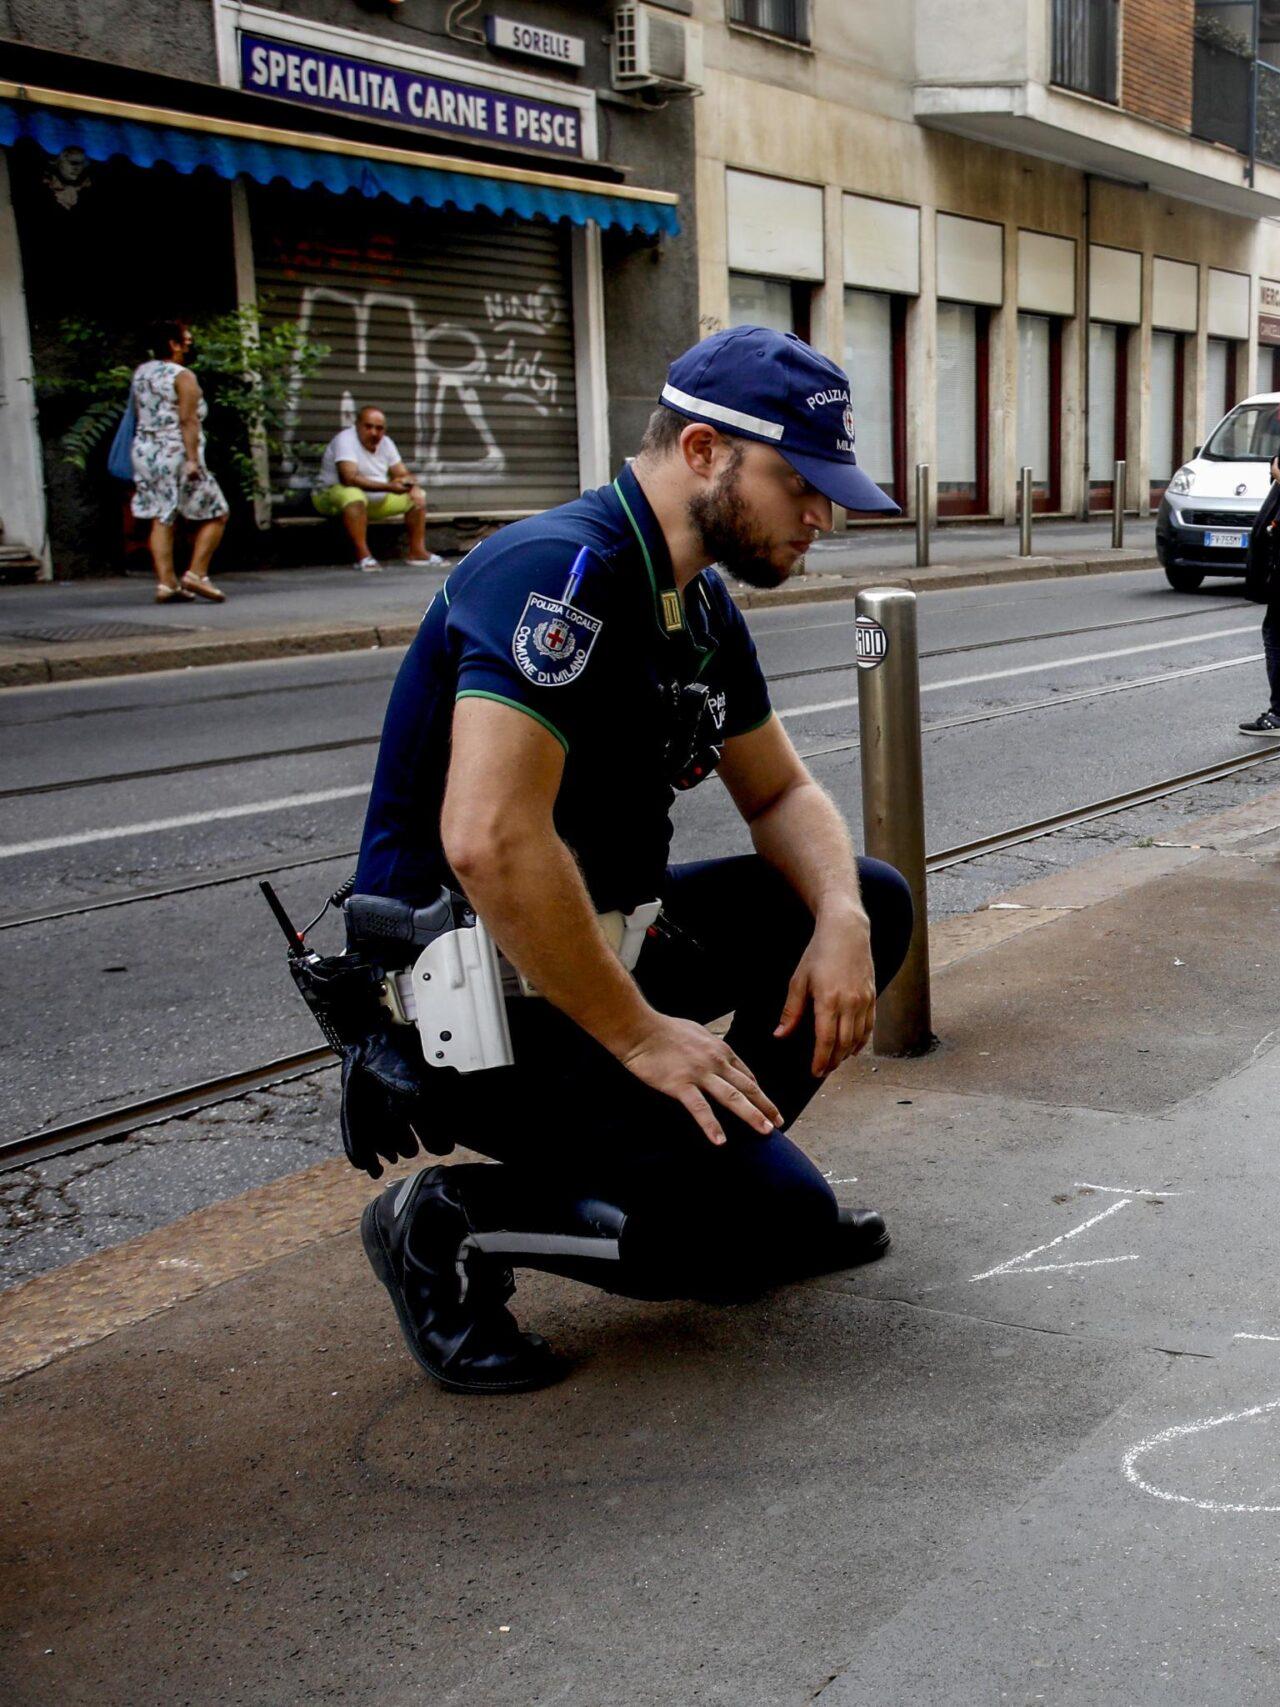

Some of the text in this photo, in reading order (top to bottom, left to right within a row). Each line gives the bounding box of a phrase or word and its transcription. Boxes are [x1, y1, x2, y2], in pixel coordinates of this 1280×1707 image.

[512, 26, 571, 59] SORELLE
[251, 47, 577, 149] SPECIALITA CARNE E PESCE
[805, 389, 850, 411] POLIZIA
[530, 597, 599, 633] POLIZIA LOCALE
[515, 625, 586, 684] COMUNE DI MILANO
